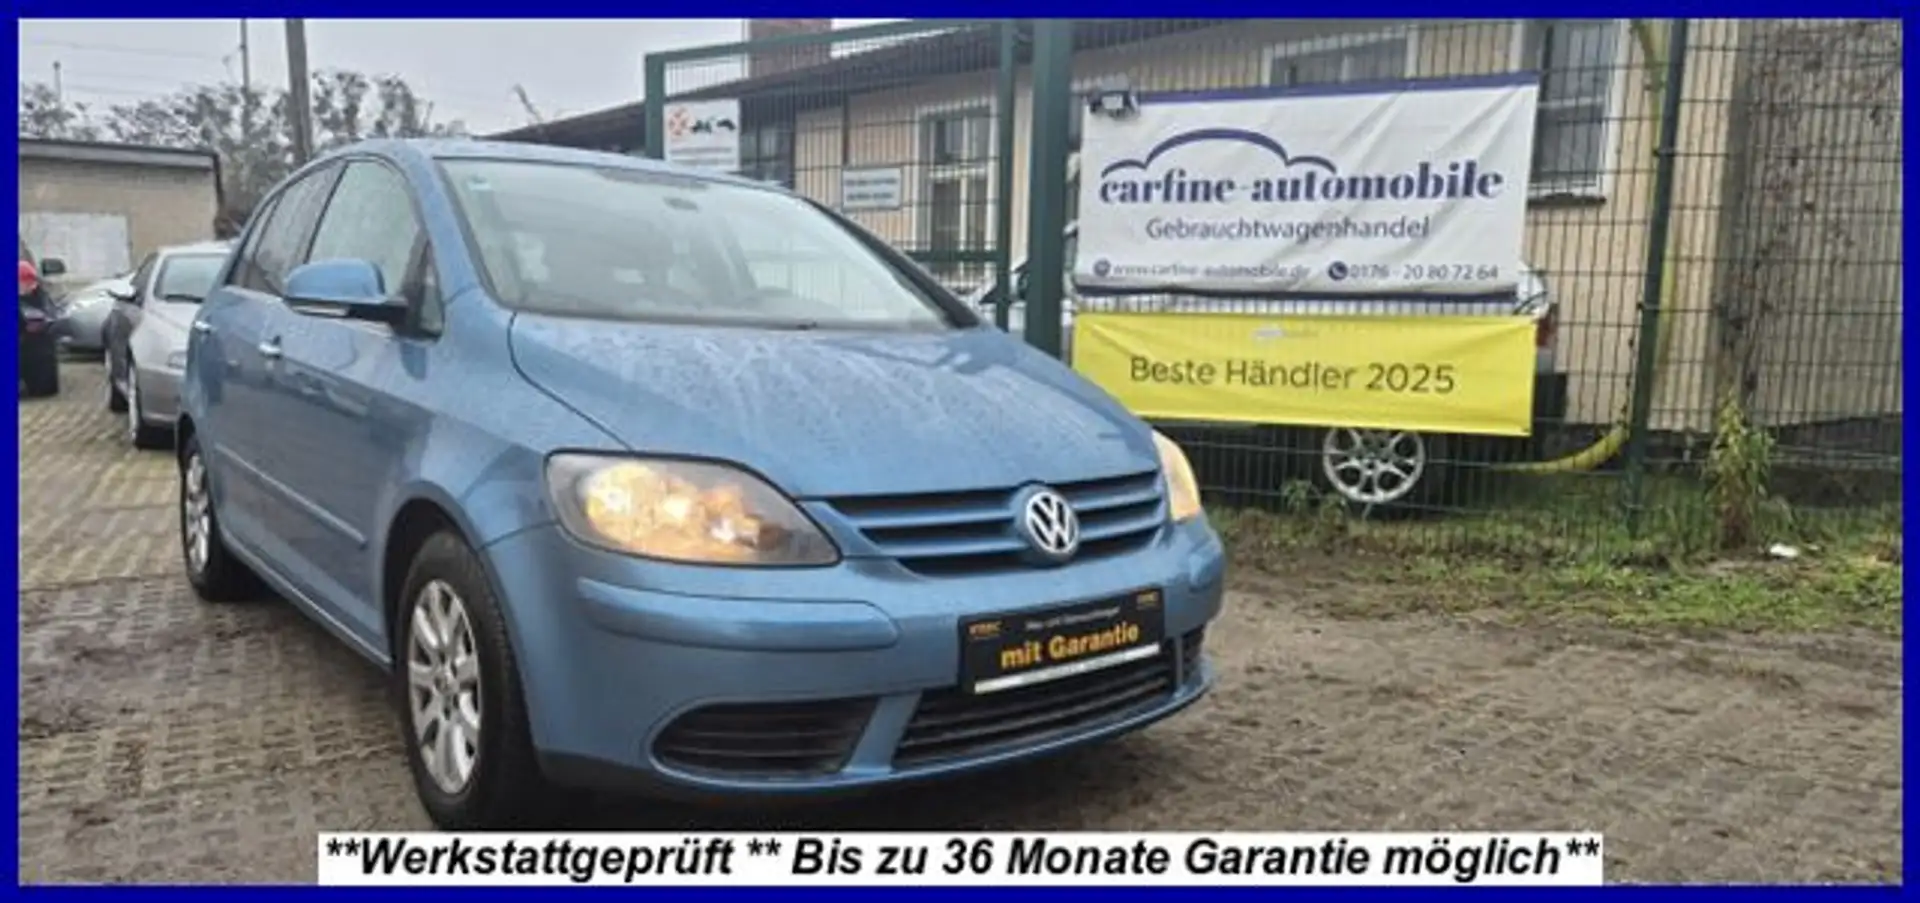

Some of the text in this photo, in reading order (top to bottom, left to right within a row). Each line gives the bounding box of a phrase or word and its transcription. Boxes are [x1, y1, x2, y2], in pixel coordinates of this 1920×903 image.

[1099, 160, 1504, 203] carfine-automobile
[1144, 215, 1430, 242] Gebrauchtwagenhandel
[1350, 263, 1390, 279] 0176
[1403, 264, 1424, 280] 20
[1427, 264, 1448, 280] 80
[1452, 264, 1473, 280] 72
[1476, 264, 1499, 279] 64
[1130, 355, 1455, 394] Beste Händler 2025
[1001, 621, 1140, 669] mit Garantie
